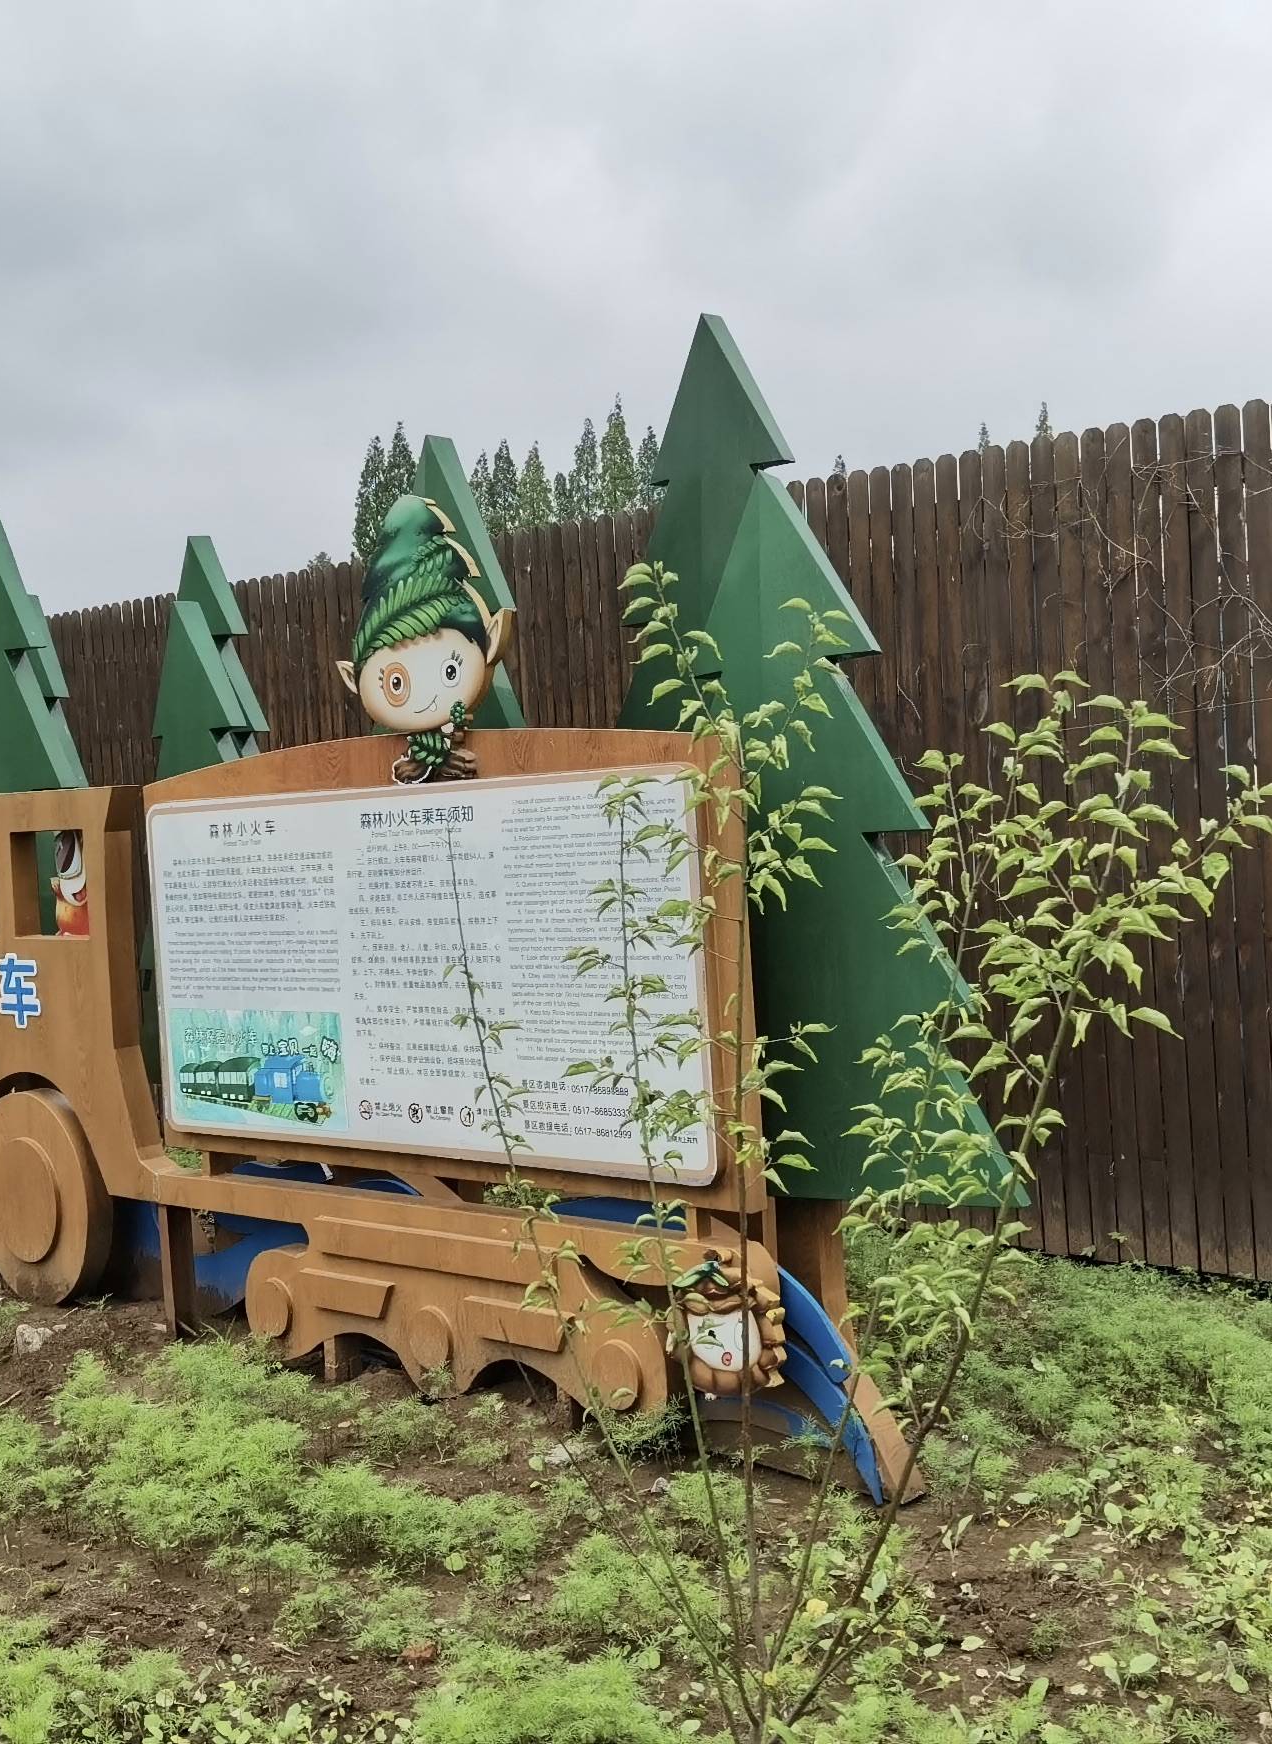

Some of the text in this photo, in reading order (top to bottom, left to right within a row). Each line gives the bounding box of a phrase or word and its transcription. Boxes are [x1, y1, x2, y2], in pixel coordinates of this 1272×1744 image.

[360, 806, 473, 829] 森林小火车乘车须知
[209, 820, 276, 839] 森林小火车
